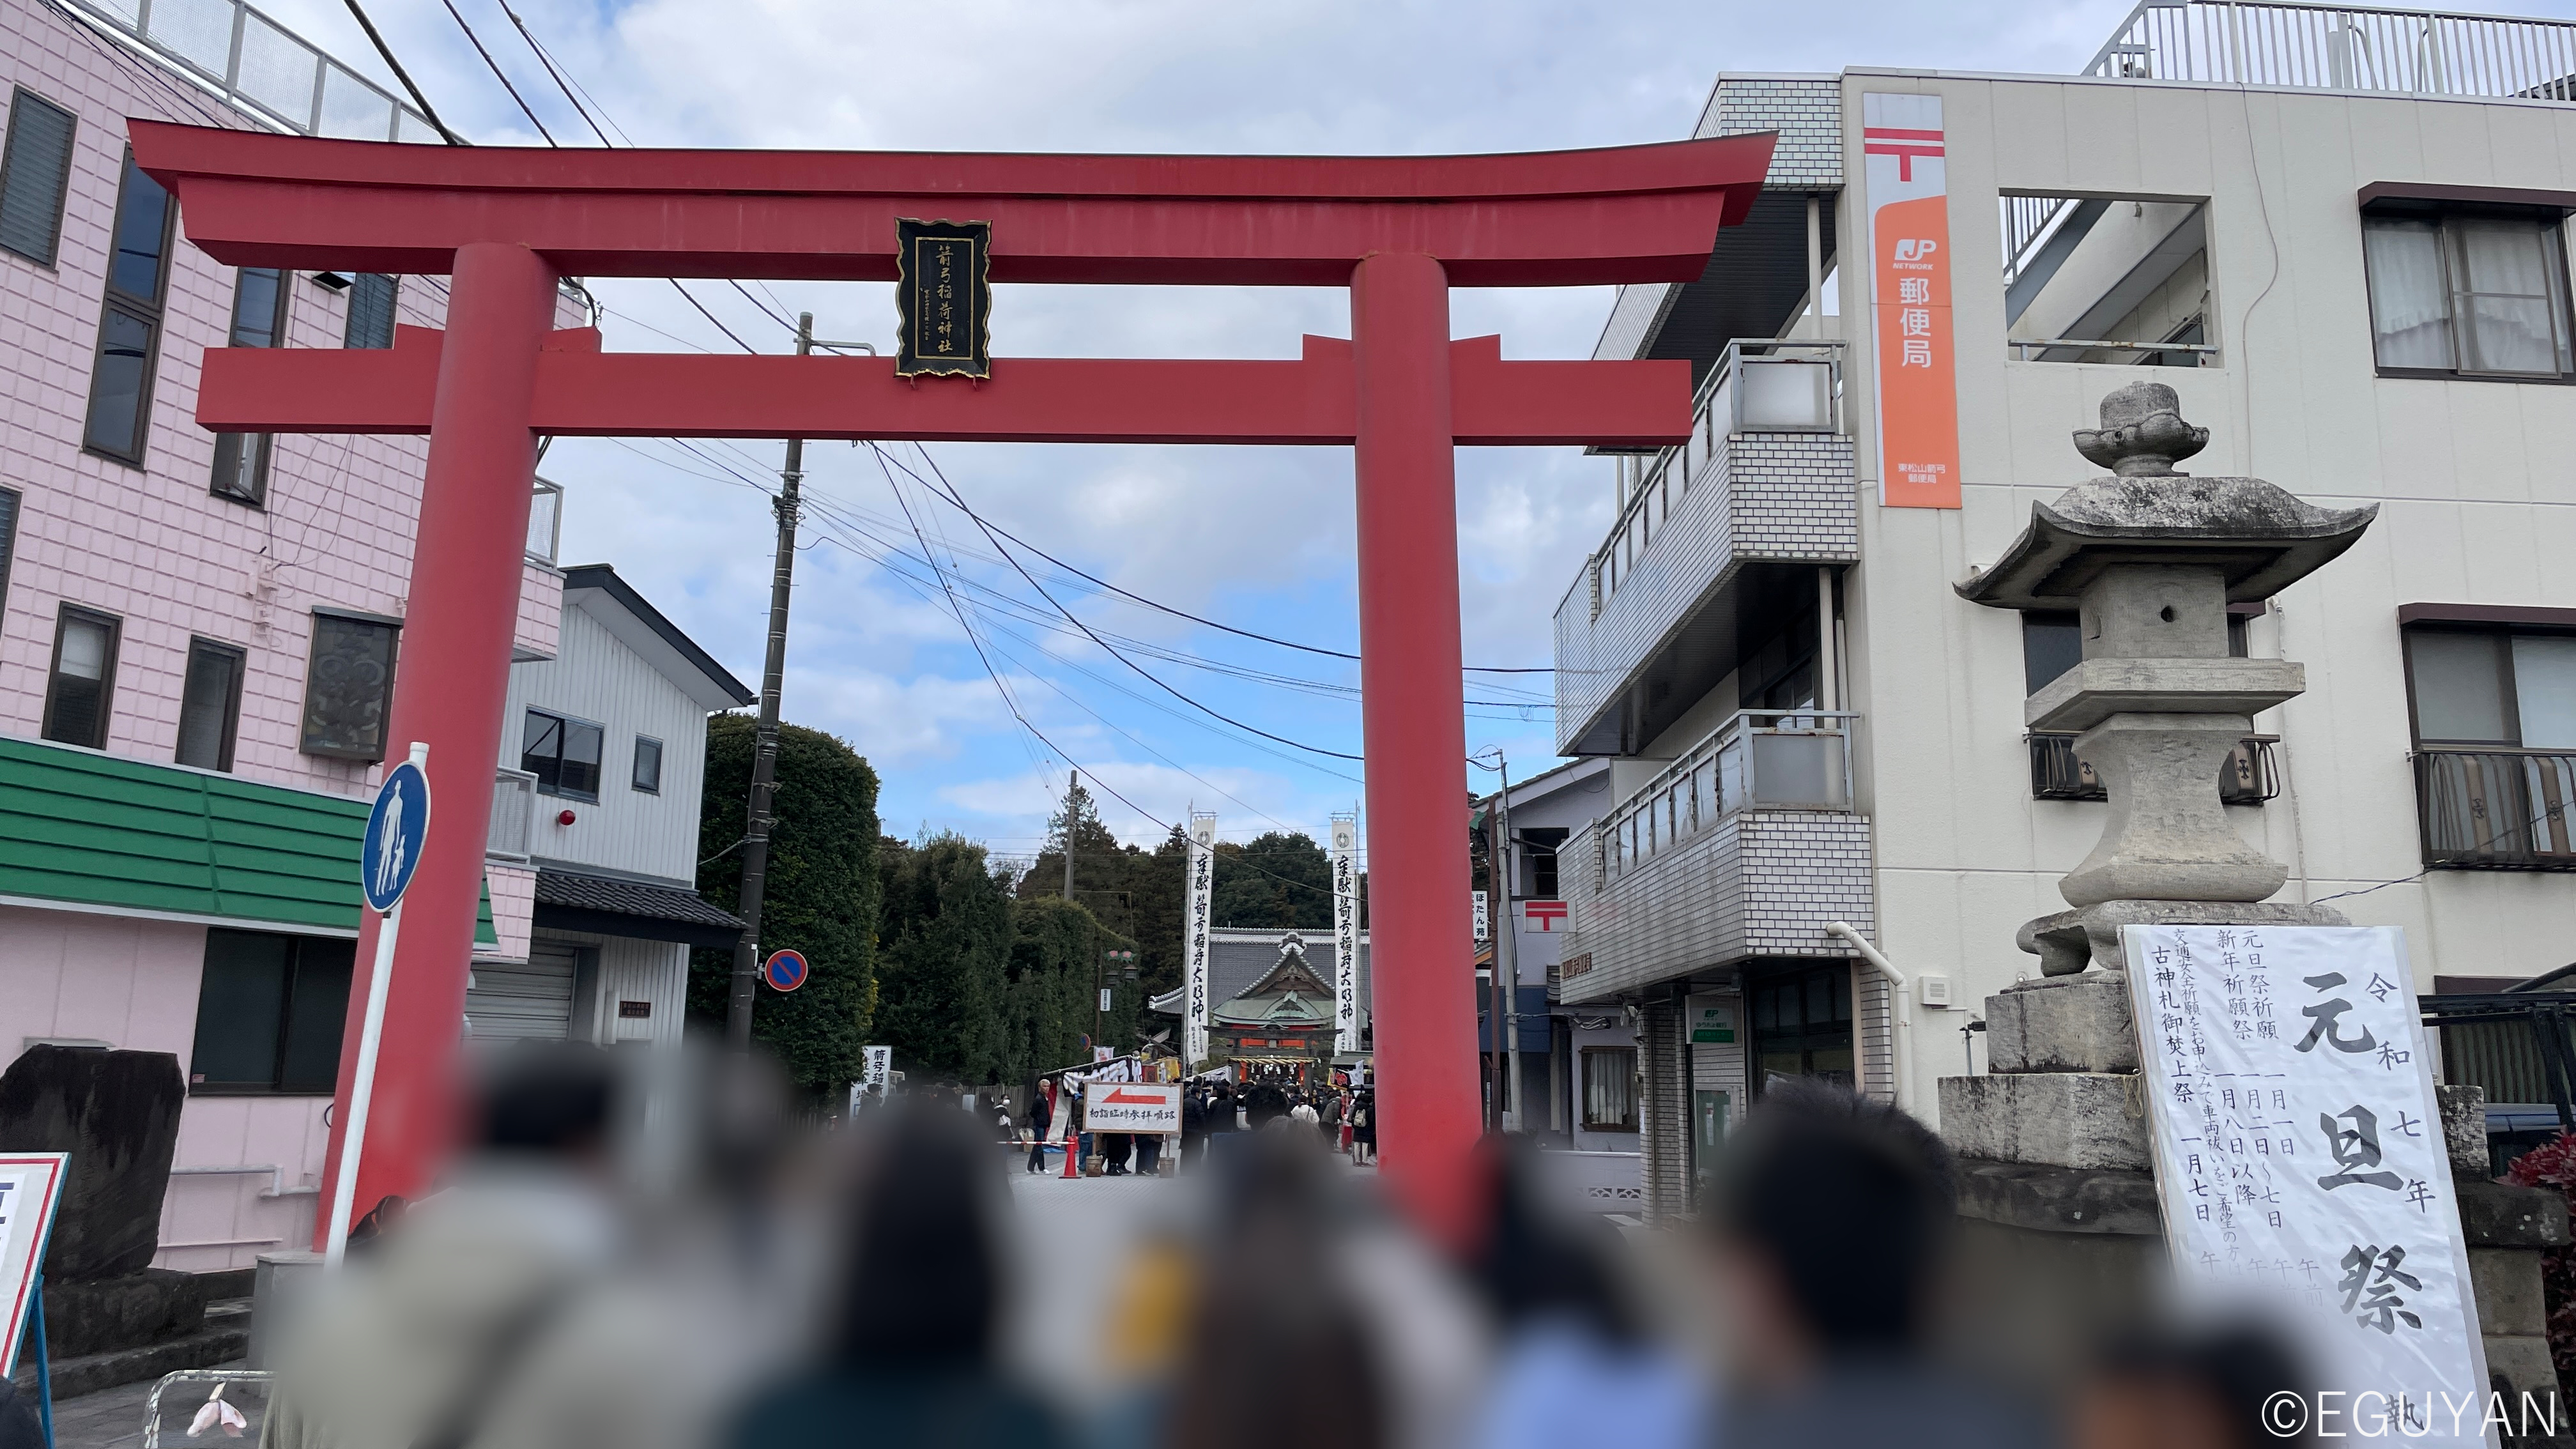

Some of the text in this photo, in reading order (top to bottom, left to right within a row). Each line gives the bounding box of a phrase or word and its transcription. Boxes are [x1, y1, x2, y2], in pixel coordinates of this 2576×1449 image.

[1895, 239, 1936, 261] JP
[1900, 277, 1931, 368] 郵便局
[1898, 463, 1945, 474] 東松山箭弓
[1908, 473, 1936, 484] 郵便局
[2217, 929, 2253, 1040] 新年祈願祭
[2242, 930, 2280, 1039] 元旦祭祈願
[2264, 1072, 2294, 1155] 一月一日
[2152, 946, 2194, 1103] 古神札御焚上祭
[2181, 1135, 2210, 1222] 一月七日
[2214, 1072, 2257, 1206] 一月八日以降
[2365, 972, 2436, 1214] 令和七年
[2294, 971, 2423, 1335] 元旦祭
